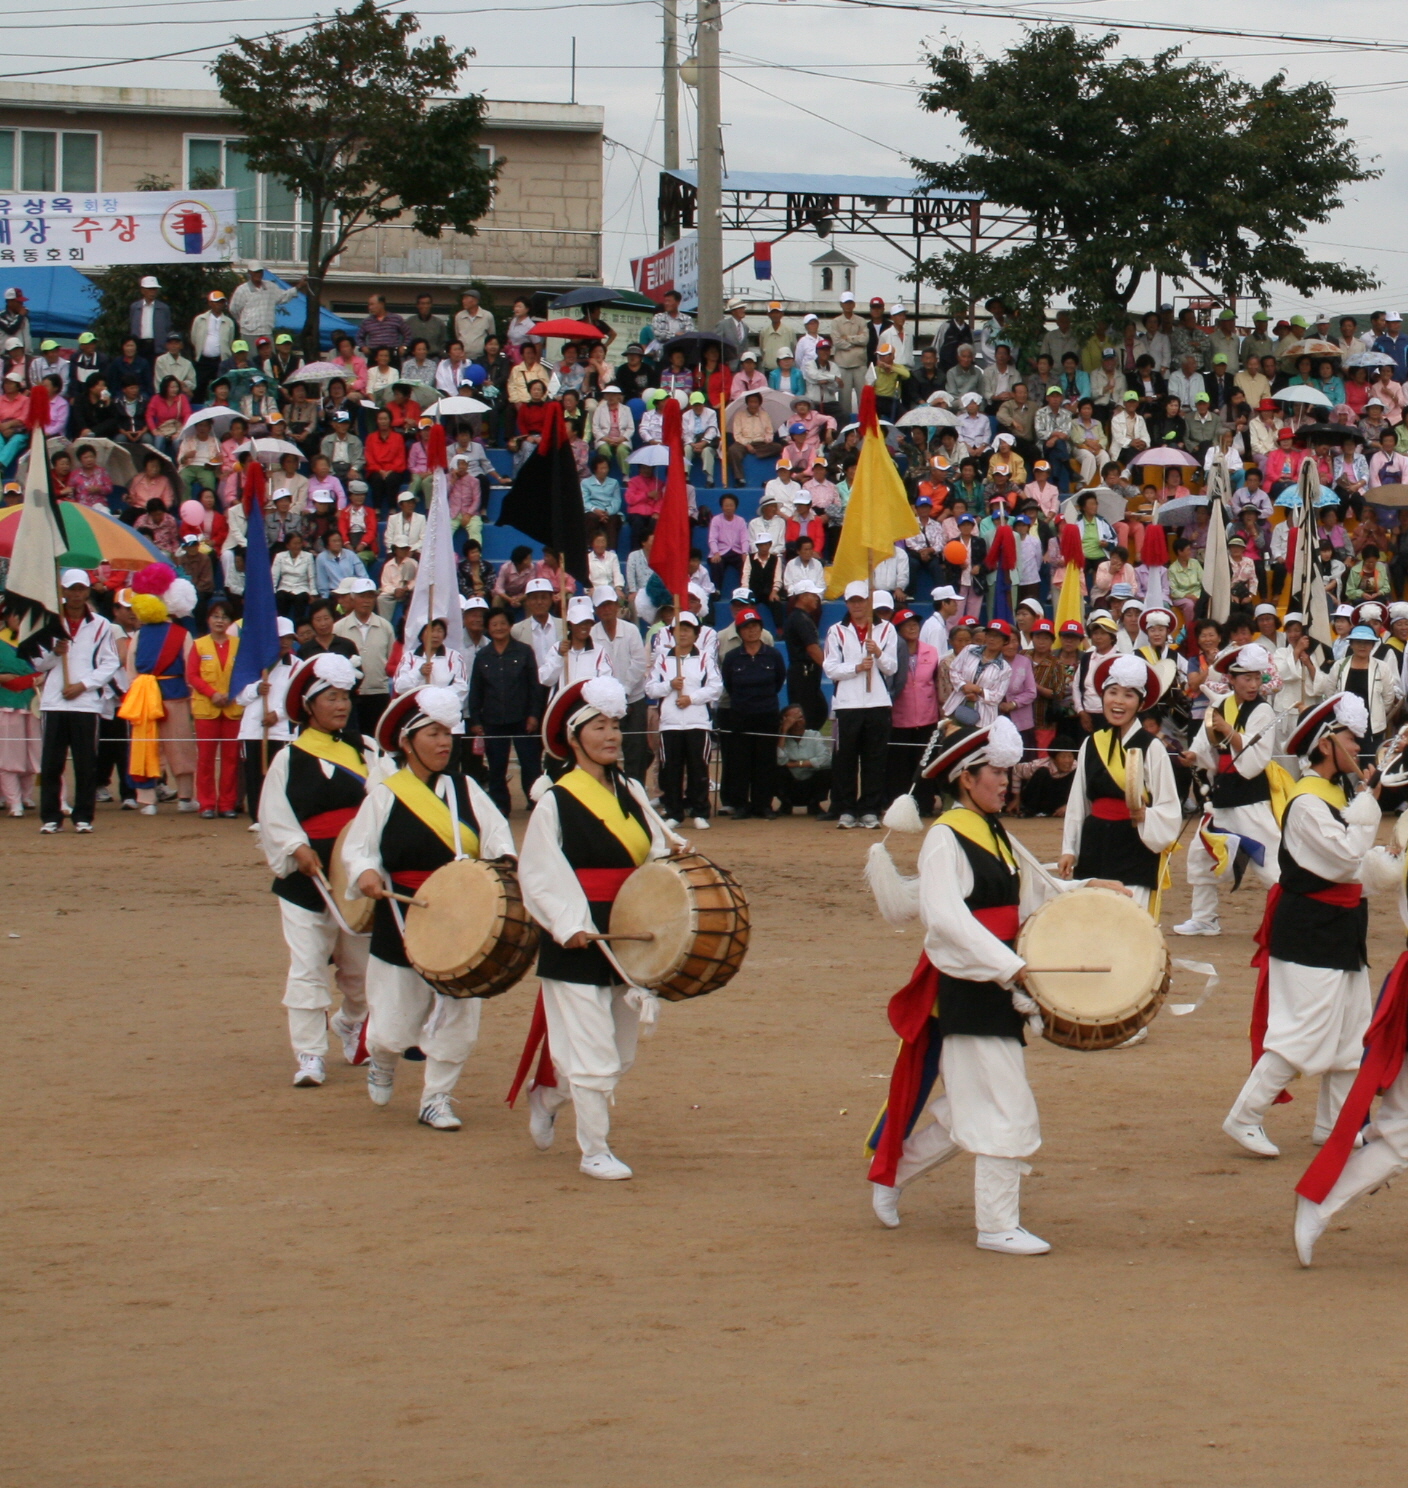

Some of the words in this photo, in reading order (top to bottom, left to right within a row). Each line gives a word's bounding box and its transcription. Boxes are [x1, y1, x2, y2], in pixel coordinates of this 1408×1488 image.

[84, 198, 118, 213] 회장
[71, 215, 140, 243] 수상
[1, 247, 84, 262] 육동호회
